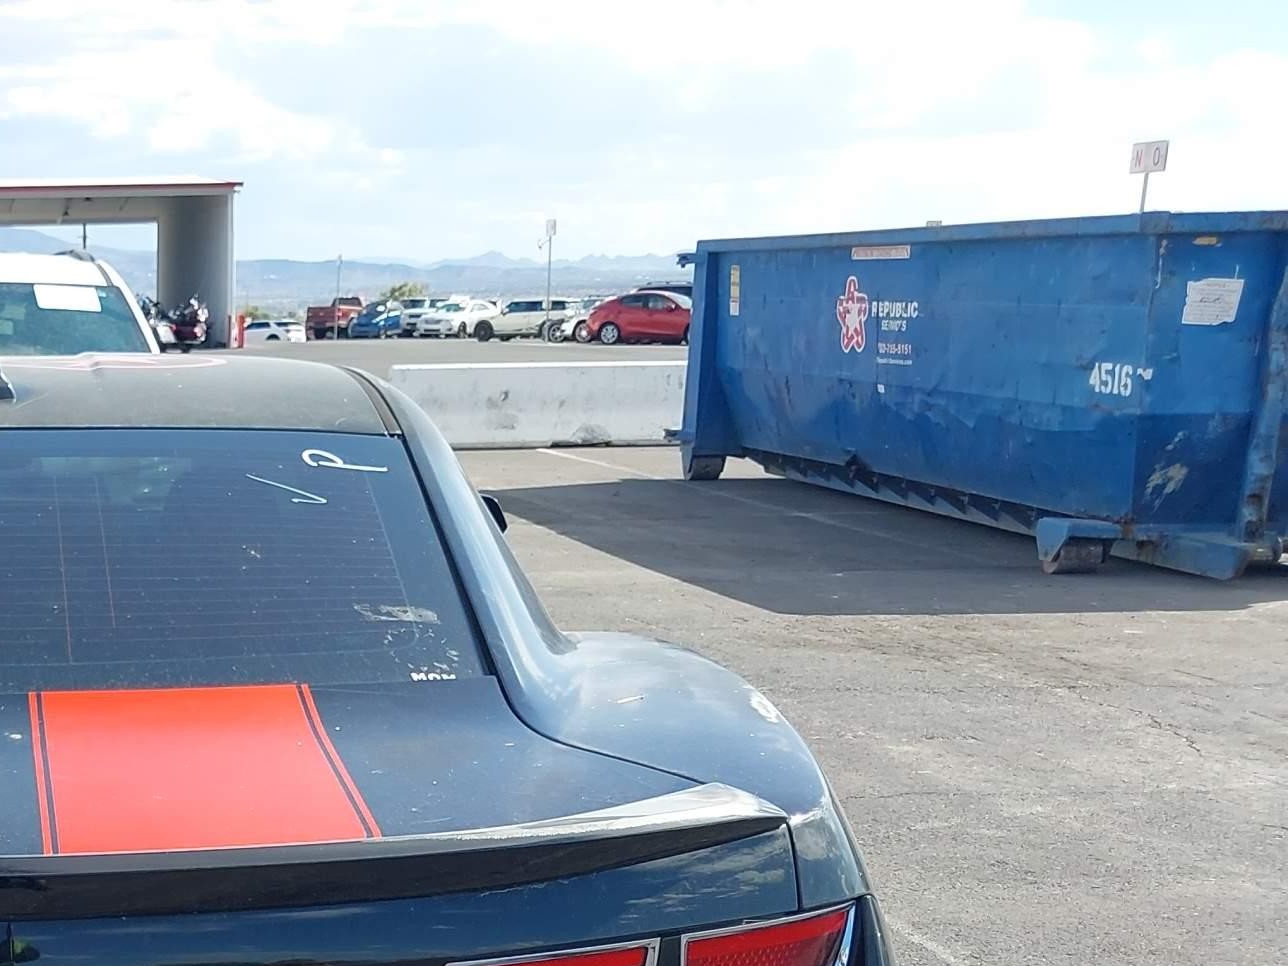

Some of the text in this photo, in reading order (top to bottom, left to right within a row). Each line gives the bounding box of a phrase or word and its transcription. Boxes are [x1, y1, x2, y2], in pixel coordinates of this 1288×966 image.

[871, 301, 919, 319] REPUBLIC
[881, 320, 907, 332] SERVS
[1089, 362, 1133, 397] 4516
